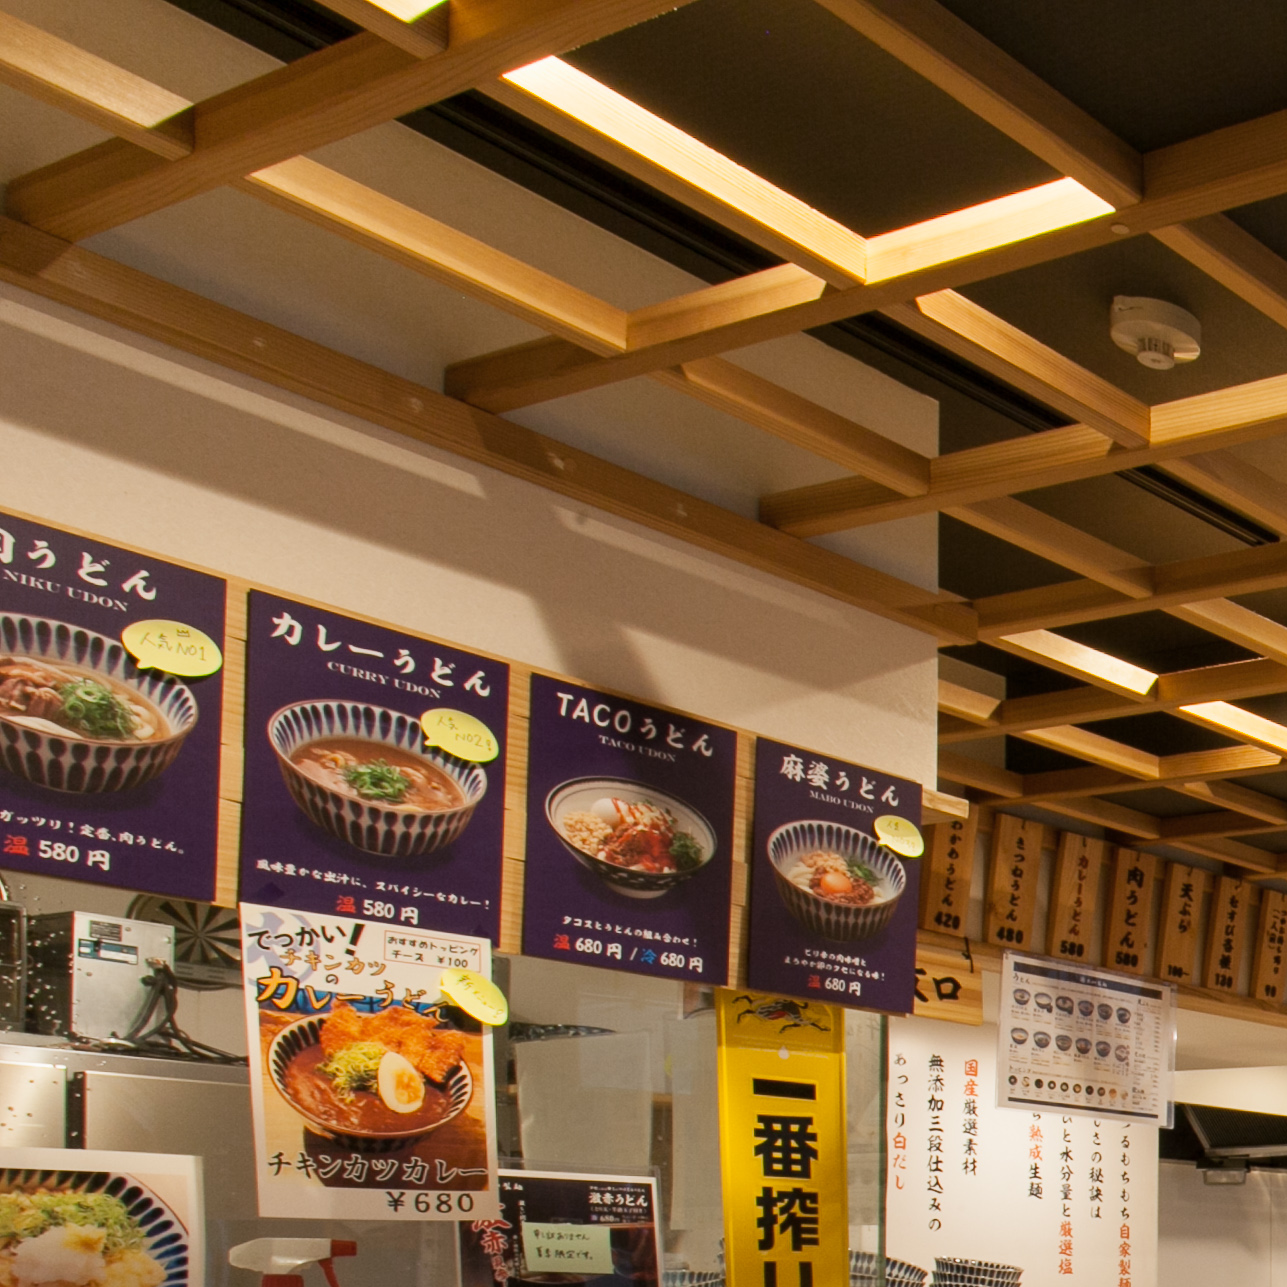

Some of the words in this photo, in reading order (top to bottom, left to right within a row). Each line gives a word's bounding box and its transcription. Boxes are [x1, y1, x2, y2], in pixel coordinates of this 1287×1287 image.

[3, 569, 59, 594] NIKU
[67, 585, 128, 612] UDON
[271, 611, 491, 697] カレーうどん
[327, 661, 389, 686] CURRY
[394, 678, 441, 699] UDON
[598, 735, 635, 753] TACO
[639, 746, 676, 763] UDON
[779, 754, 900, 808] 麻婆うどん
[809, 790, 841, 805] MABO
[843, 799, 874, 814] UDON
[38, 840, 110, 871] 580円
[1006, 837, 1025, 922] きつねうどん
[362, 900, 419, 925] 580円
[934, 911, 961, 930] 420
[1119, 866, 1145, 950] 肉うどん
[386, 935, 480, 956] おすすめトッピング
[996, 927, 1024, 944] 480
[1060, 940, 1084, 957] 580
[279, 950, 386, 976] チキンカツ
[392, 950, 424, 962] チーズ
[575, 938, 623, 961] 680円
[660, 952, 703, 973] 680円
[1115, 951, 1139, 968] 580
[256, 967, 451, 1023] カレーうどん
[825, 977, 861, 996] 680円
[892, 1053, 908, 1191] あっさり白だし
[962, 1059, 980, 1176] 国産厳選素材
[927, 1054, 945, 1232] 無添加三段仕込みの
[268, 1151, 489, 1183] チキンカツカレー
